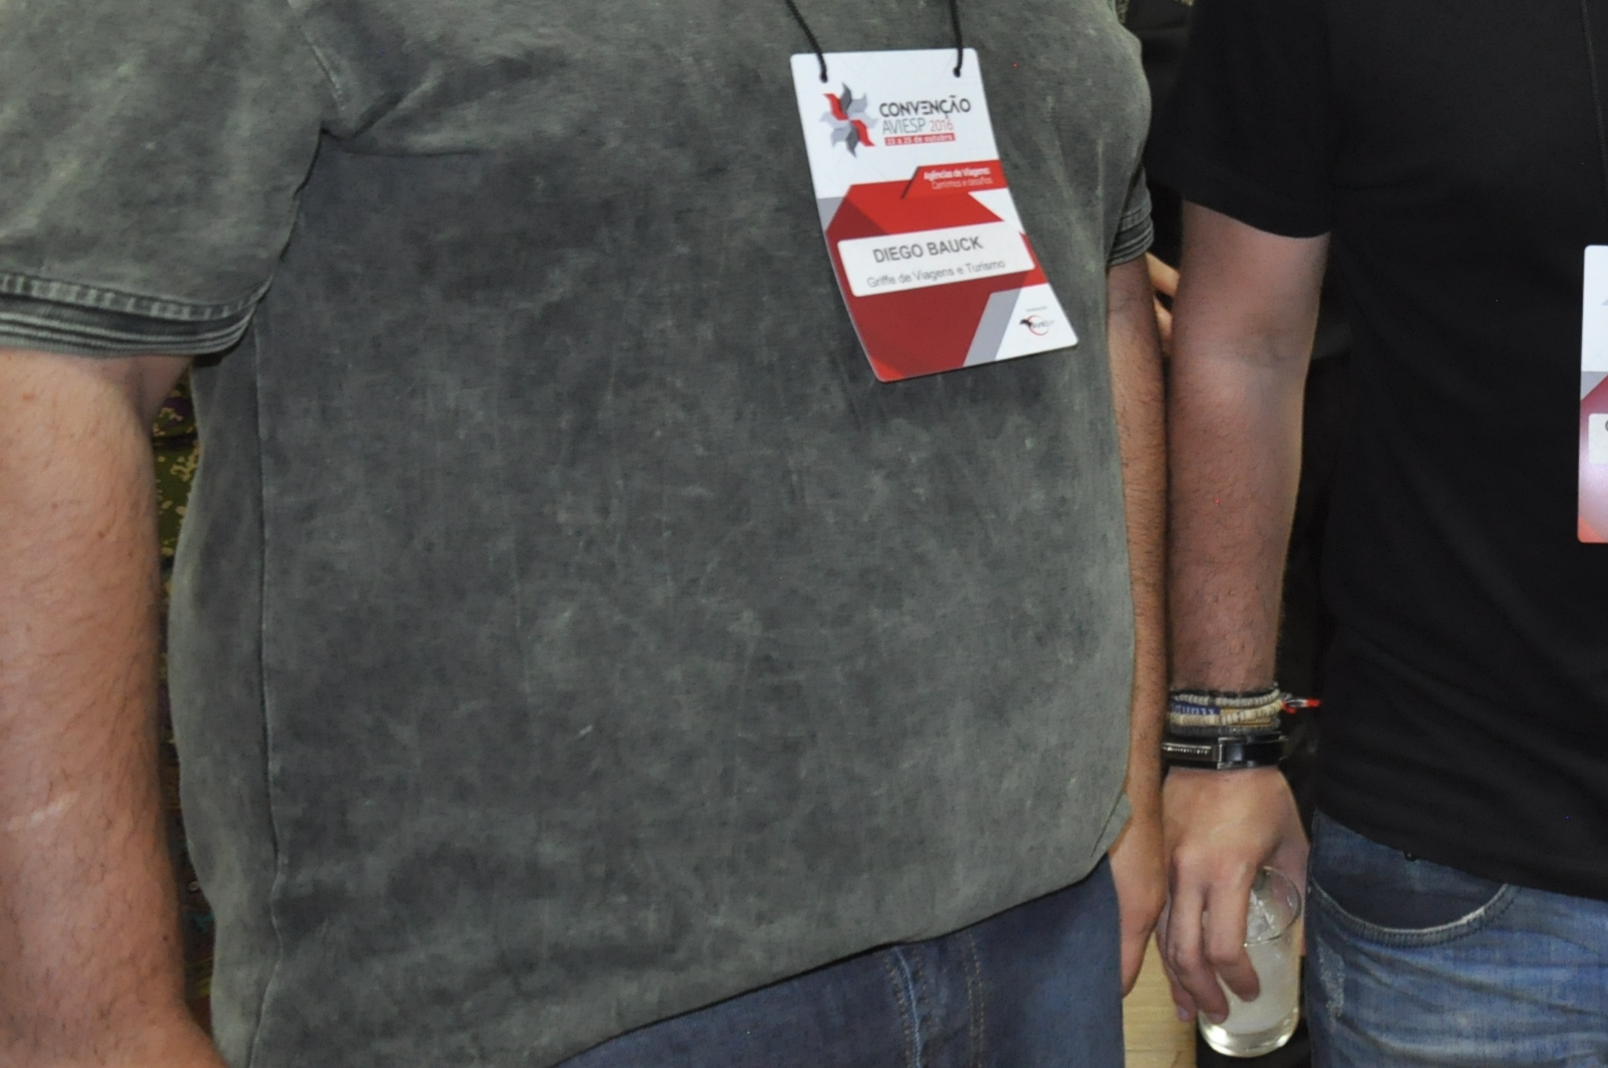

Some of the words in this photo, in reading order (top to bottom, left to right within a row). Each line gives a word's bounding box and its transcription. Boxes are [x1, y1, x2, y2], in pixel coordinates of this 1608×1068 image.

[879, 95, 971, 119] CONVENÇÃO
[882, 117, 926, 135] AVIESP
[929, 119, 954, 132] 2016
[873, 243, 924, 263] DIEGO
[926, 236, 983, 256] BAUCK
[867, 274, 896, 288] Griffe
[898, 273, 912, 284] de
[912, 266, 955, 281] Viagens
[956, 267, 964, 275] e
[964, 260, 1006, 273] Turismo
